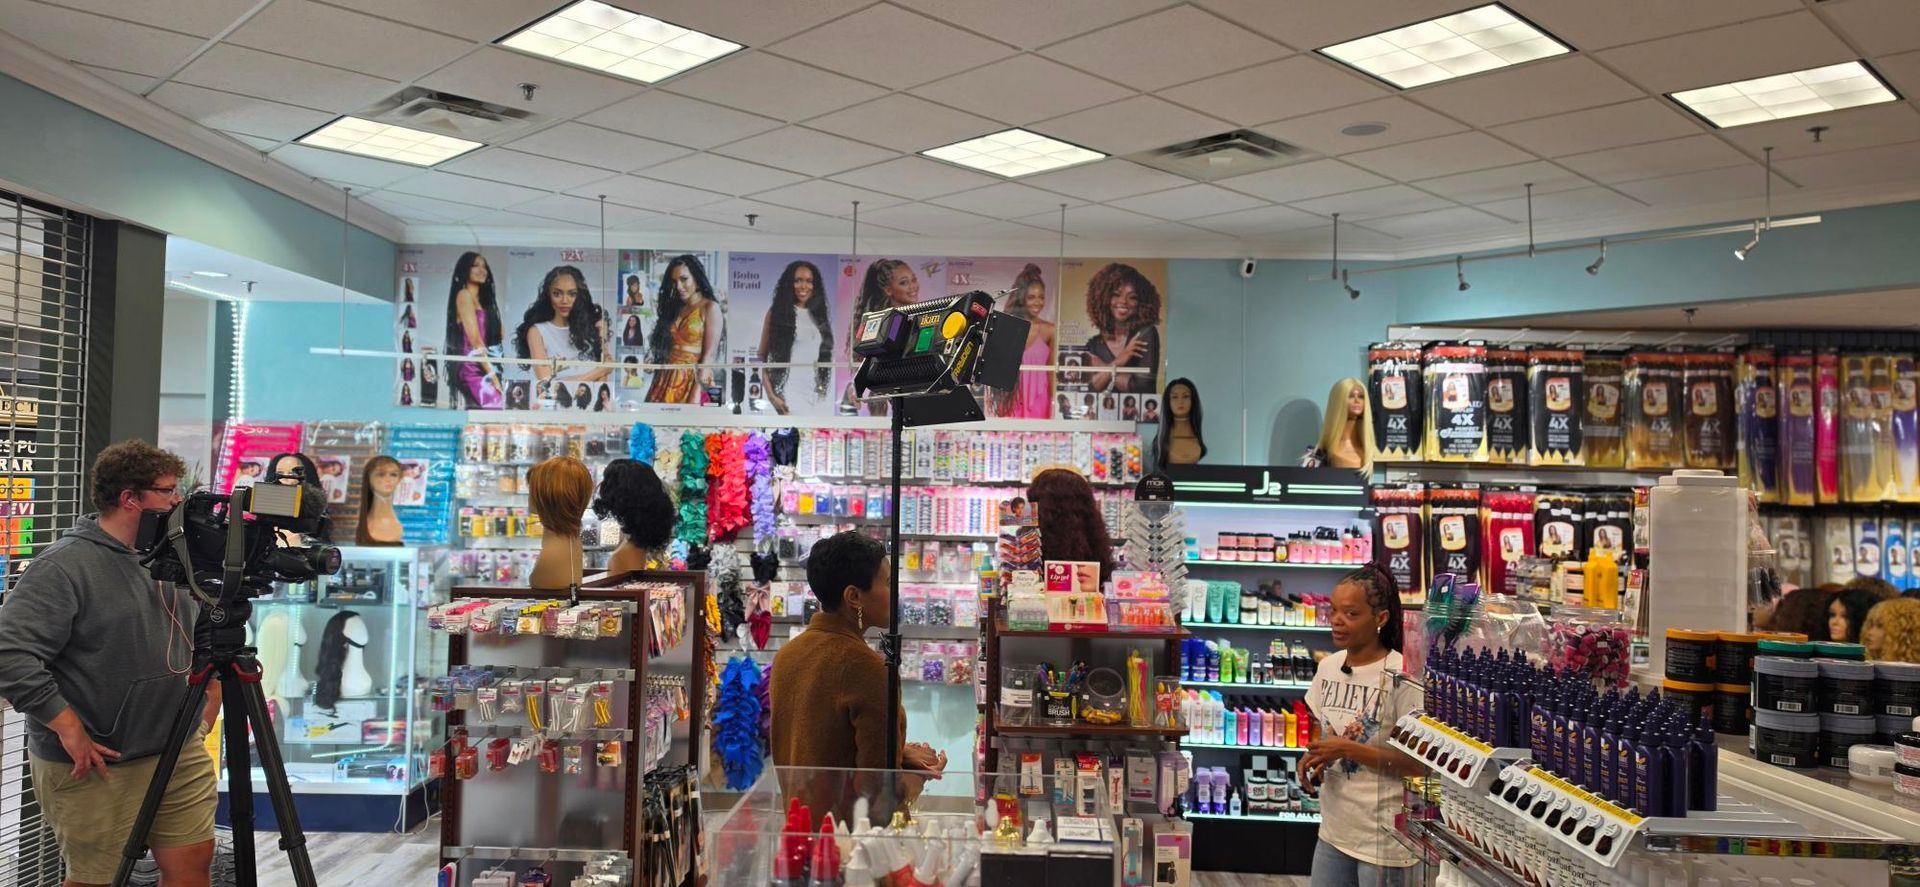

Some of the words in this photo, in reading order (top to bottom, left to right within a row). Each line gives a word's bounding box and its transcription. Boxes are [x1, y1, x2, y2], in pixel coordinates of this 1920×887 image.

[560, 250, 584, 262] 12X
[733, 280, 761, 289] Braid
[952, 273, 970, 285] 4X
[921, 314, 940, 326] ikan
[1386, 417, 1408, 430] 4X
[1451, 413, 1474, 426] 4X
[1493, 417, 1513, 430] 4X
[1548, 416, 1569, 430] 4X
[1252, 471, 1282, 495] J2
[1390, 557, 1410, 570] 4X
[1447, 556, 1468, 569] 4X
[1320, 679, 1389, 724] BELIEVE
[1047, 708, 1070, 716] BRUSH
